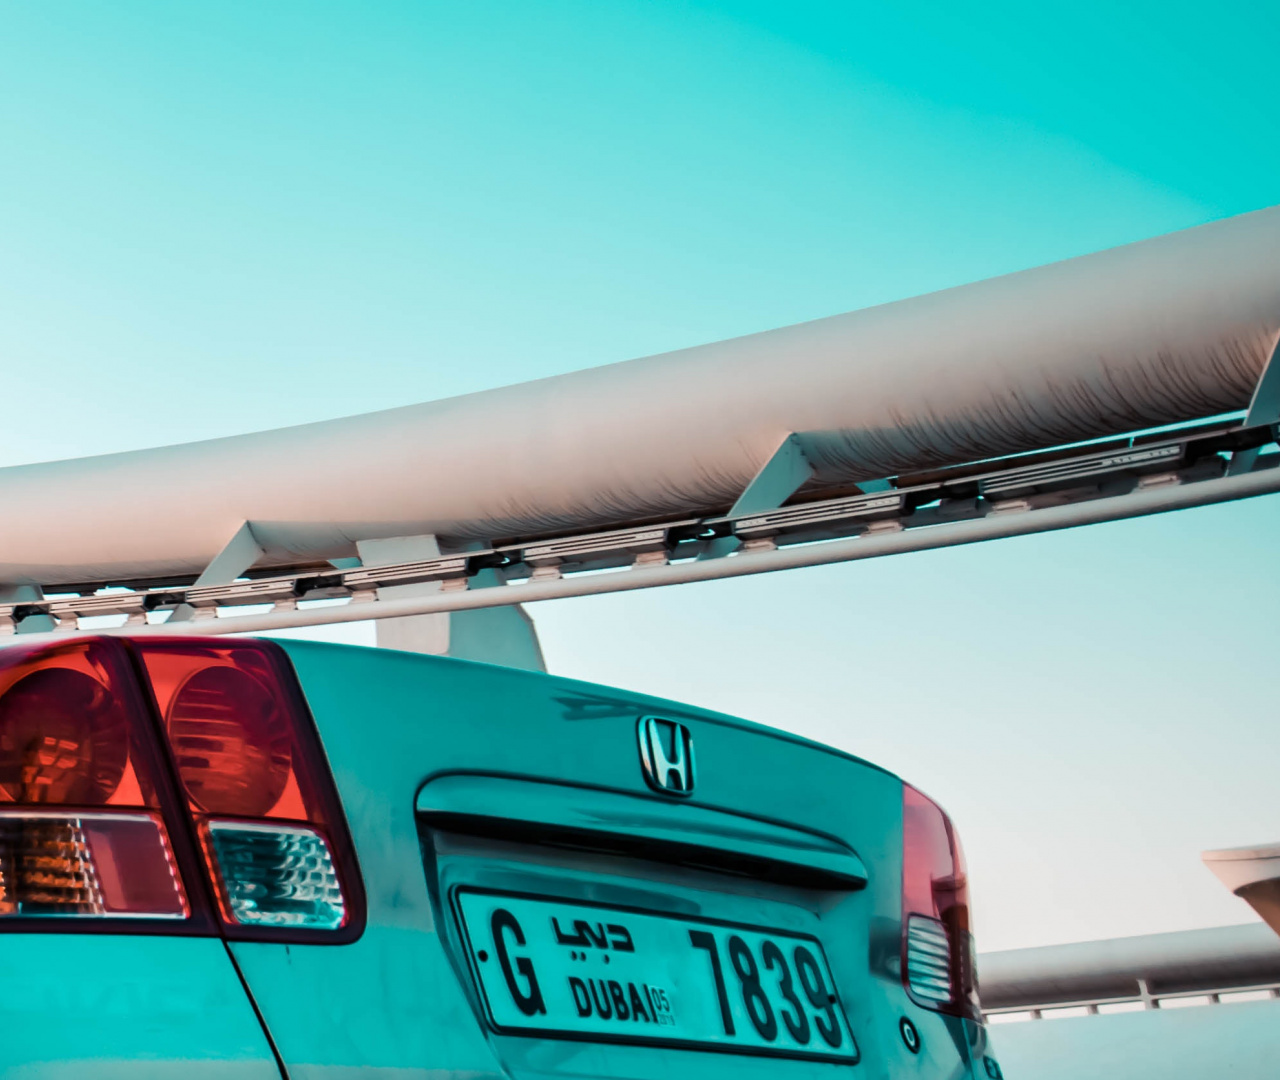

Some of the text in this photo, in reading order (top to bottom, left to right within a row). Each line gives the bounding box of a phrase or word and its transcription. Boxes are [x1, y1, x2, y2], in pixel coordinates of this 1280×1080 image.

[490, 907, 546, 1016] G
[550, 915, 635, 965] دبي
[567, 976, 659, 1024] DUBAI
[687, 929, 843, 1048] 7839
